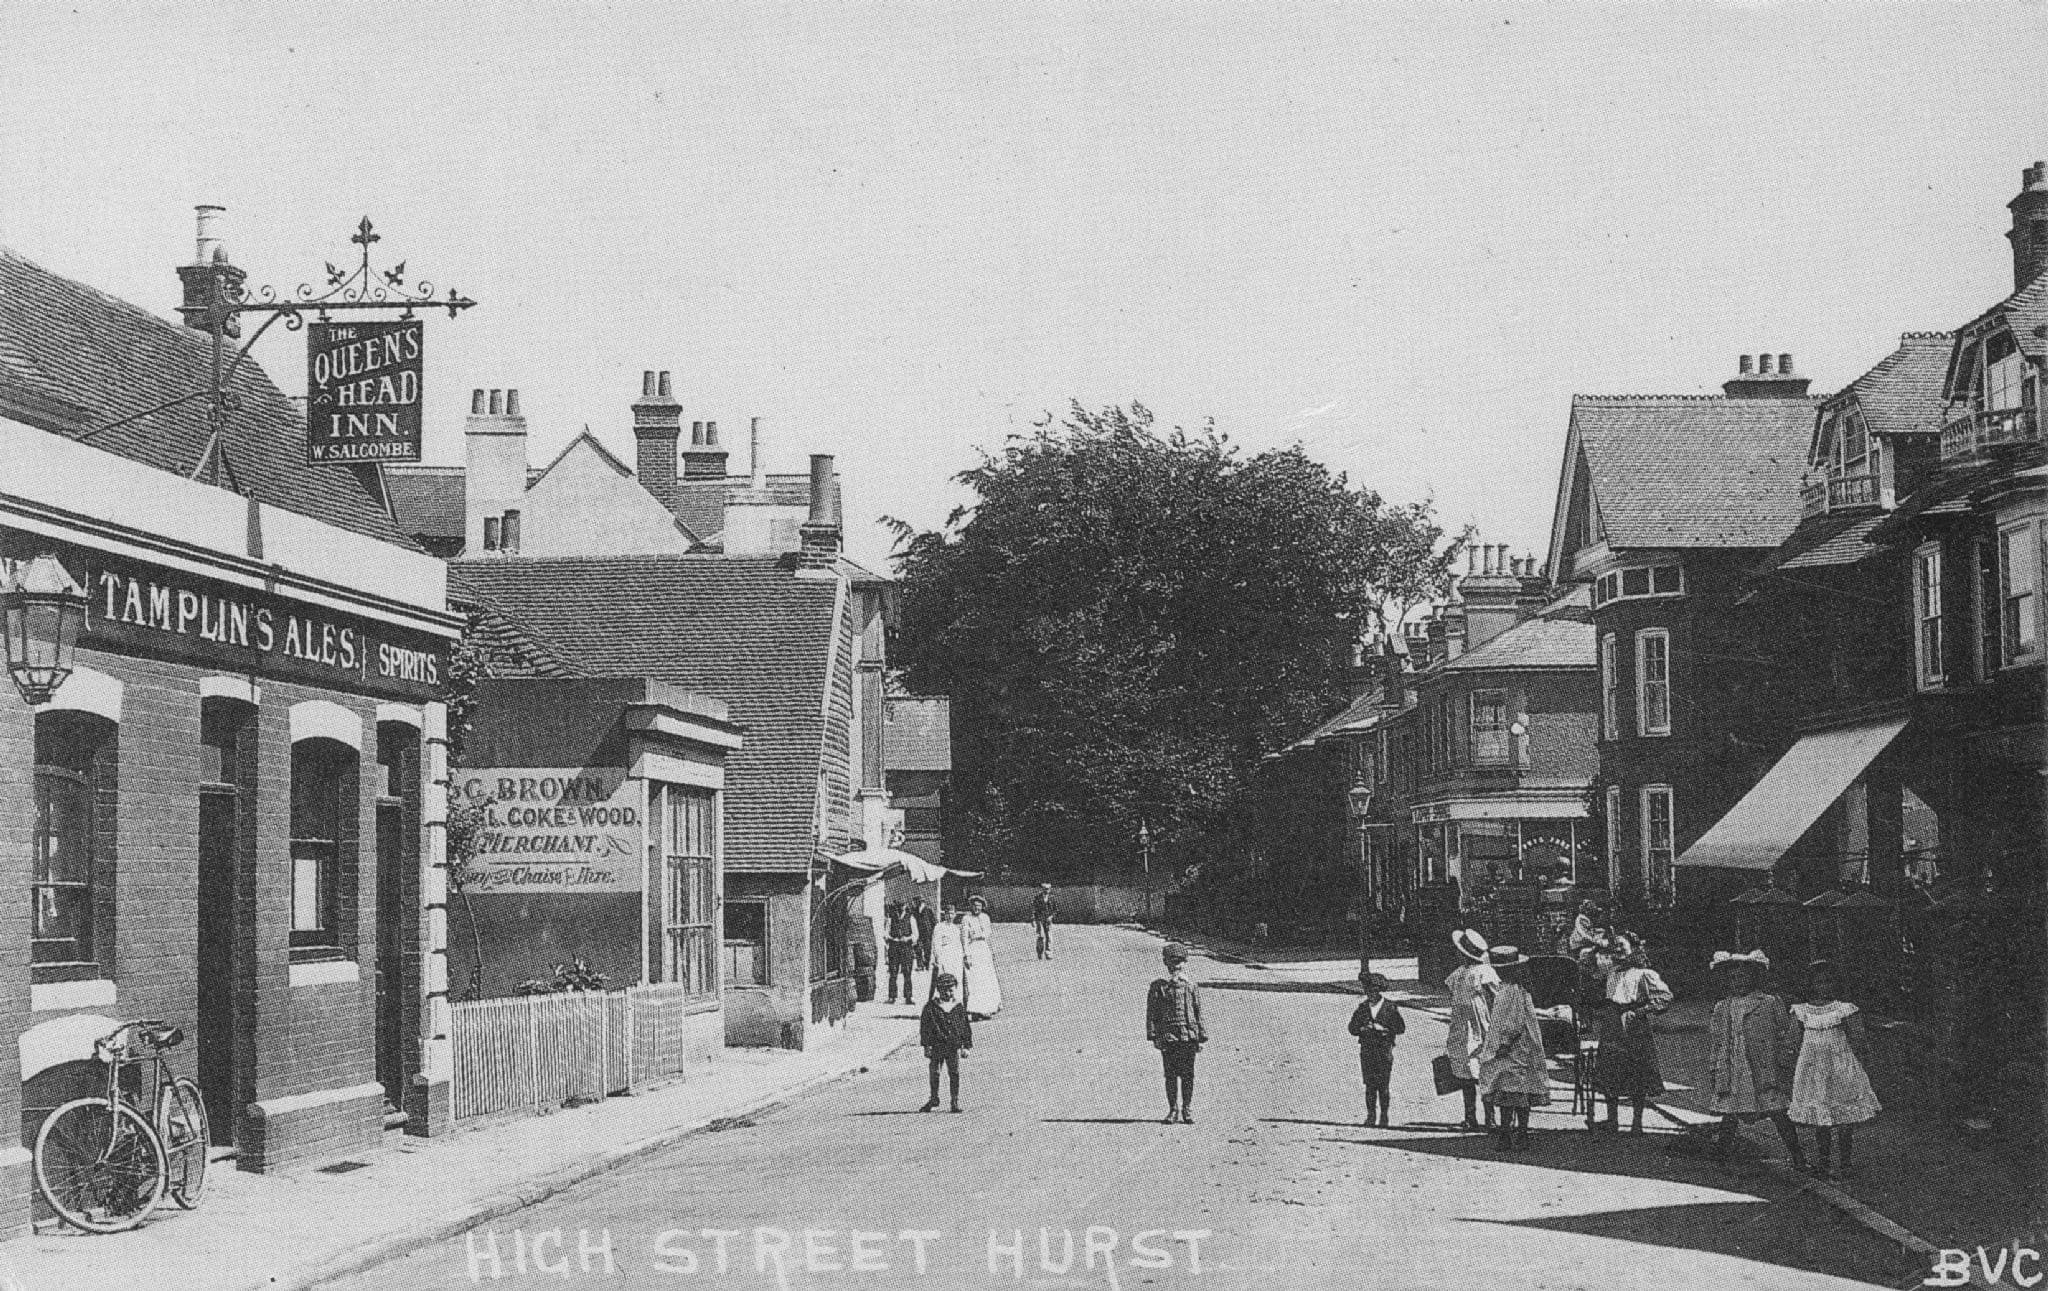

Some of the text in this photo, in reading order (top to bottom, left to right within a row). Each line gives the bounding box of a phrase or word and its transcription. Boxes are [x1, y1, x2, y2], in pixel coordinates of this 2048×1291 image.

[329, 327, 357, 342] THE
[337, 370, 418, 406] HEAD
[329, 413, 409, 437] INN.
[497, 777, 604, 801] BROWN
[507, 807, 566, 828] COKE
